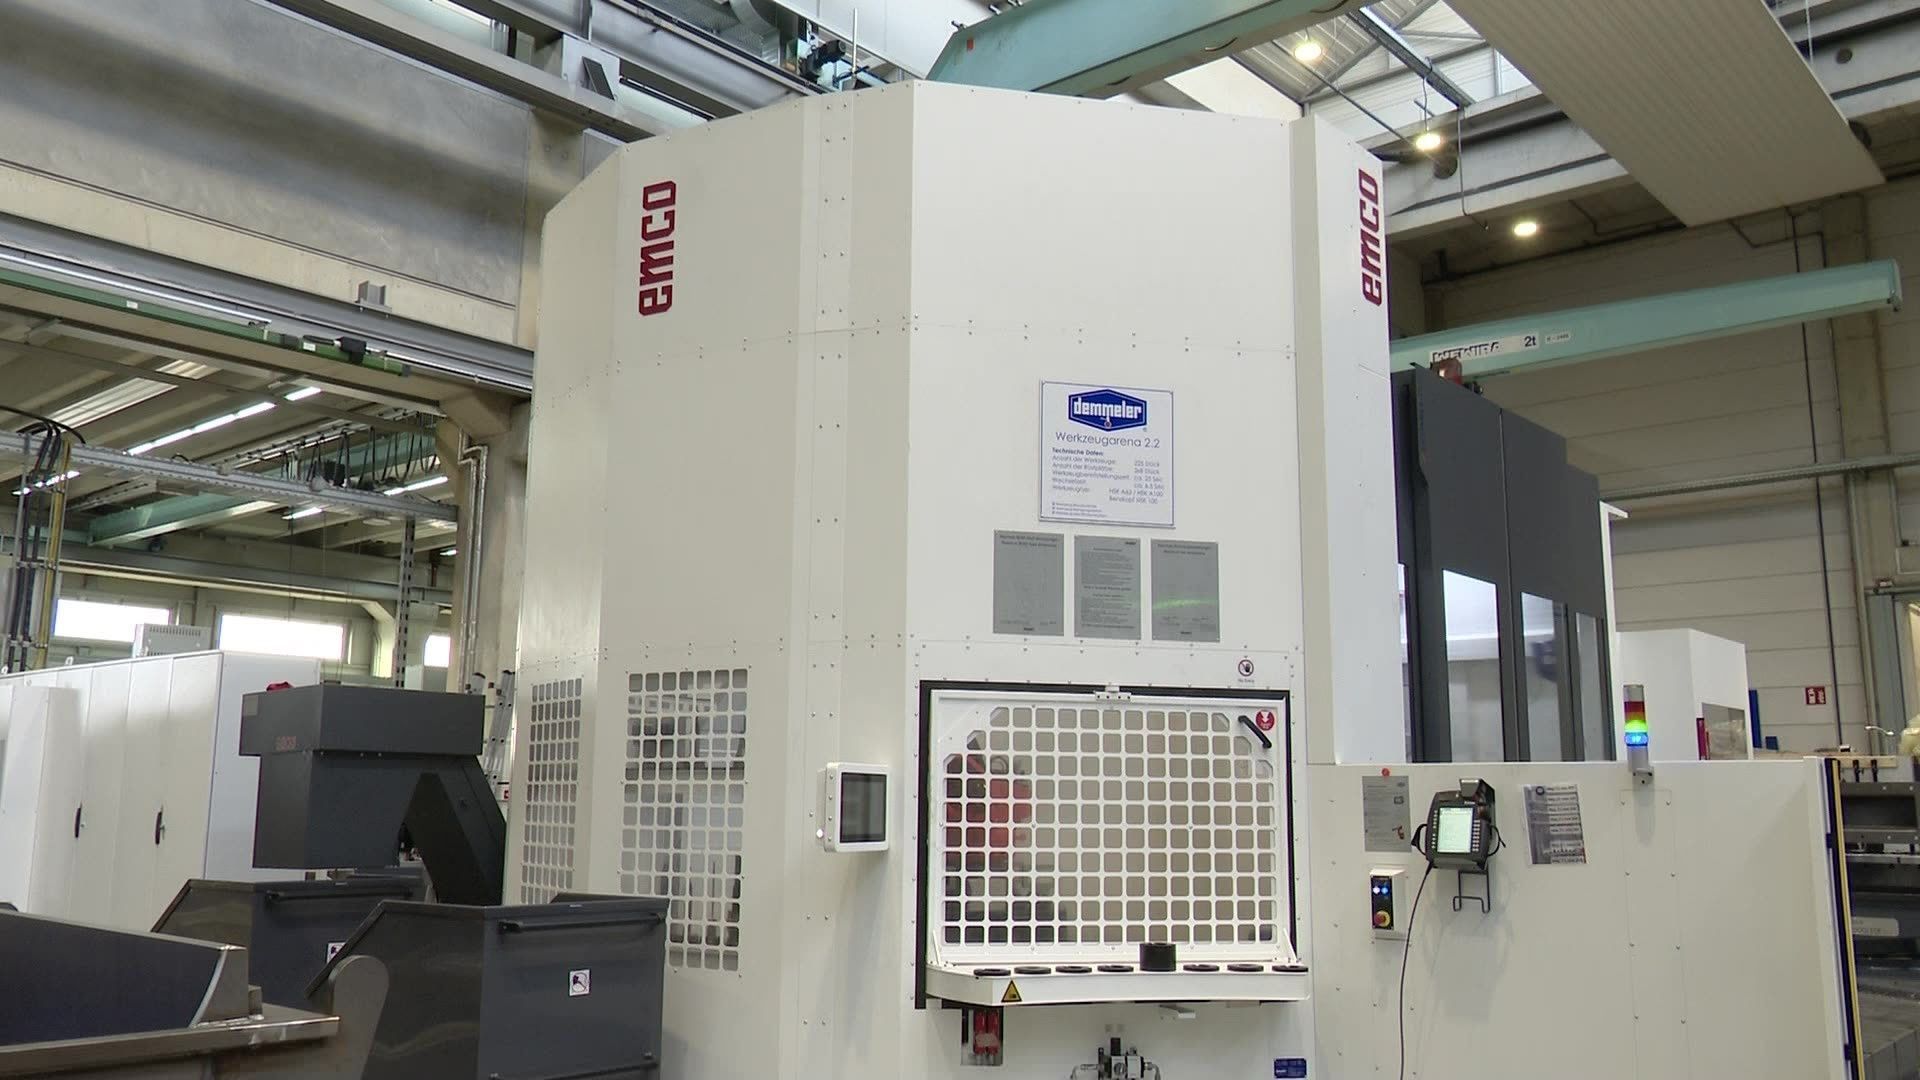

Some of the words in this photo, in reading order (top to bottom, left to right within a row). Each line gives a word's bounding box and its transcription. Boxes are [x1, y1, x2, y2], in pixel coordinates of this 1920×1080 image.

[639, 180, 676, 316] emco
[1358, 168, 1382, 307] emco
[1523, 335, 1537, 347] 2t
[1073, 397, 1142, 420] demmeler
[1055, 431, 1142, 447] Werkzeugarena
[1144, 437, 1160, 448] 2.2
